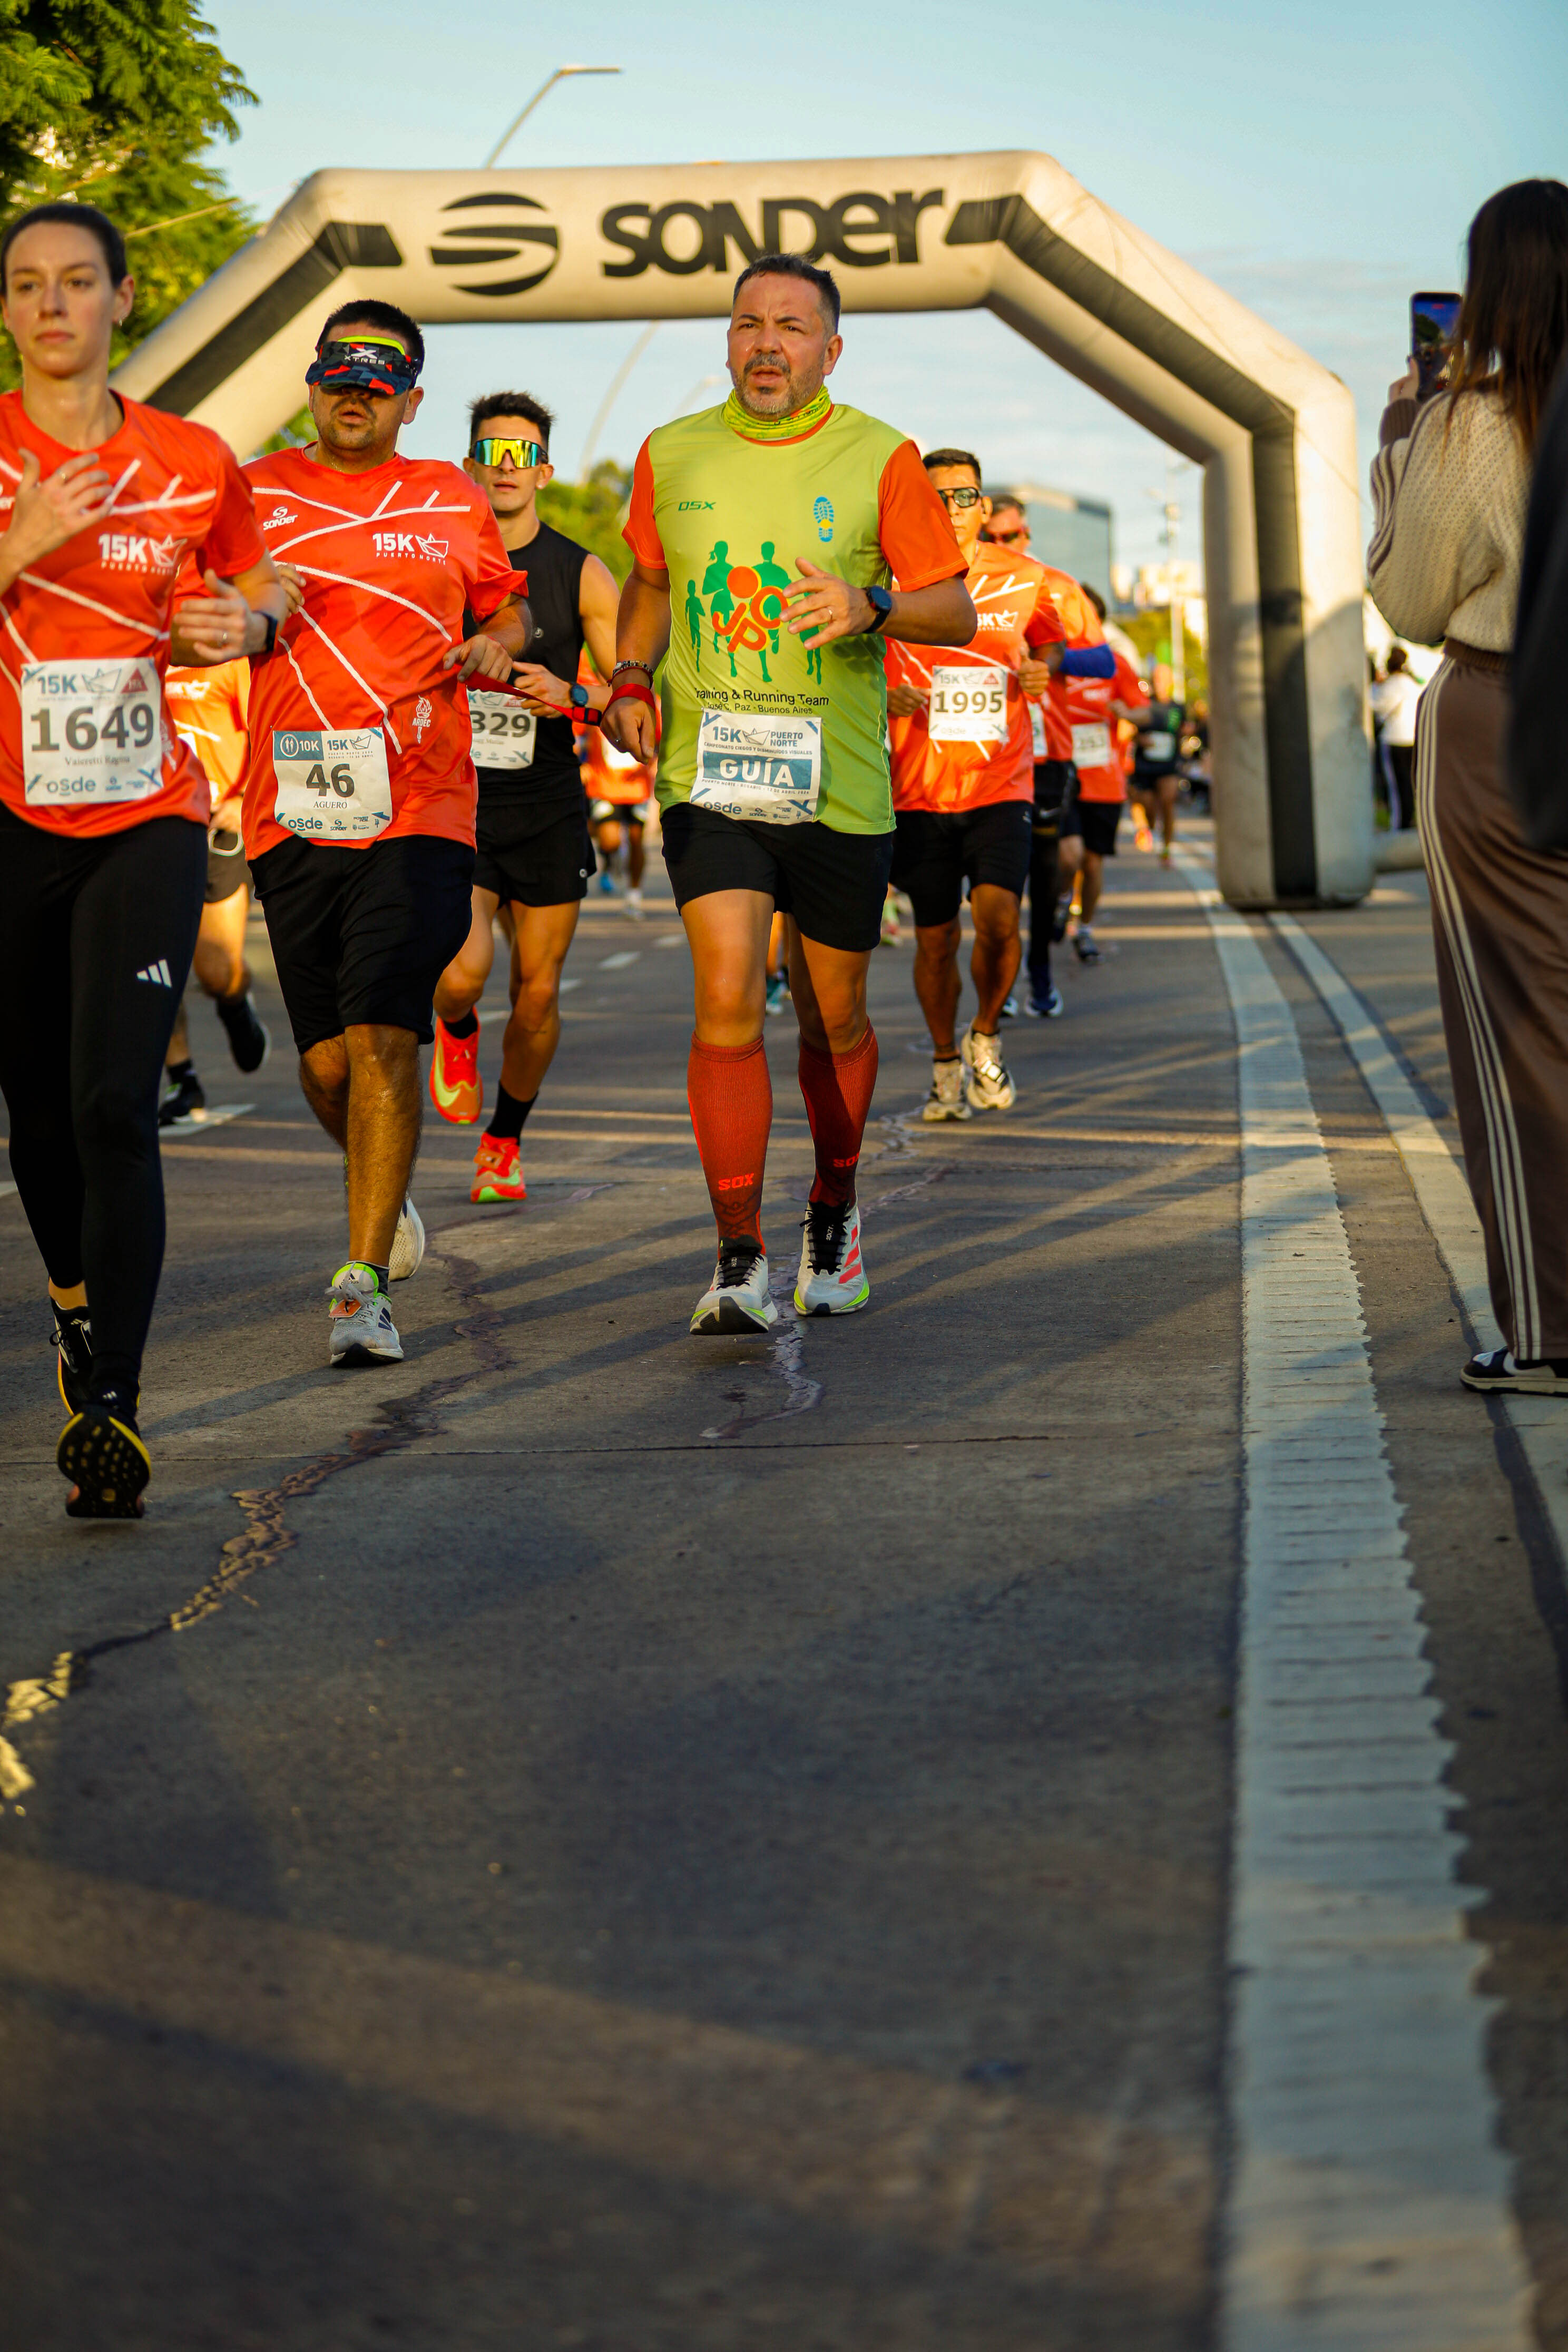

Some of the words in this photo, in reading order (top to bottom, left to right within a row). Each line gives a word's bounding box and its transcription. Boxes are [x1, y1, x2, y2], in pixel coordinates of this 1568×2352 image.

[99, 533, 148, 564] 15K
[373, 533, 415, 552] 15K
[419, 554, 446, 565] NORTE
[37, 674, 77, 694] 15K
[731, 689, 740, 700] &
[743, 689, 795, 705] Running
[797, 694, 829, 706] Team
[934, 690, 1004, 713] 1995
[734, 703, 751, 711] Paz
[758, 704, 790, 713] Buenos
[31, 703, 154, 752] 1649
[412, 717, 431, 728] ARDEC
[713, 726, 742, 743] 15K
[770, 731, 803, 740] PUERTO
[300, 740, 320, 751] 10K
[327, 739, 349, 750] 15K
[704, 741, 734, 750] CAMPEONATO
[770, 739, 798, 747] NORTE
[306, 763, 355, 798] 46
[719, 758, 795, 787] GUÍA
[46, 776, 96, 796] osde
[313, 801, 348, 809] AGUERO
[703, 800, 742, 815] osde
[288, 817, 323, 831] osde
[718, 1173, 754, 1191] SOX
